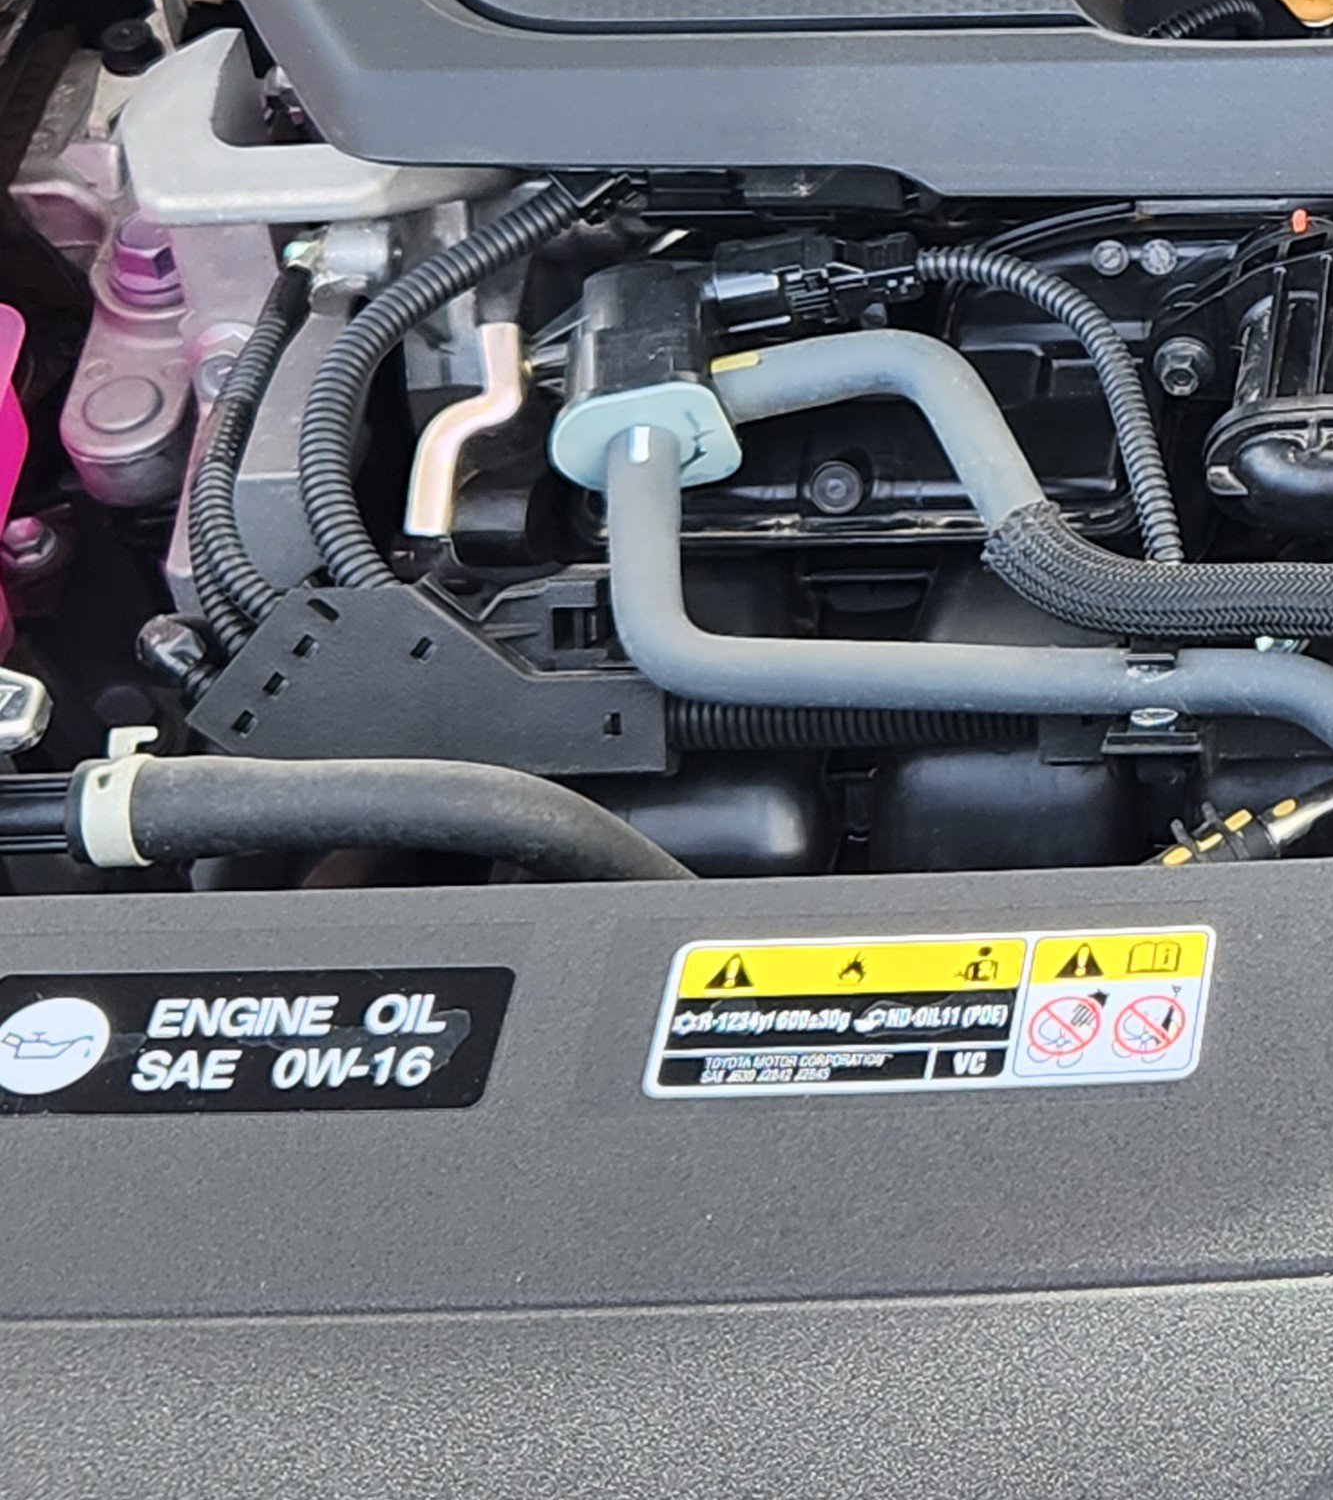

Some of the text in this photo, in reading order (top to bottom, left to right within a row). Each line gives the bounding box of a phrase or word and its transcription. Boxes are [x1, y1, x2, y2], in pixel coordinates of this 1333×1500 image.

[147, 993, 447, 1038] ENGINE OIL
[131, 1046, 436, 1091] SAE 0W-16
[703, 1054, 753, 1070] TOYOTA
[752, 1054, 799, 1069] MOTOR
[952, 1050, 989, 1077] VC
